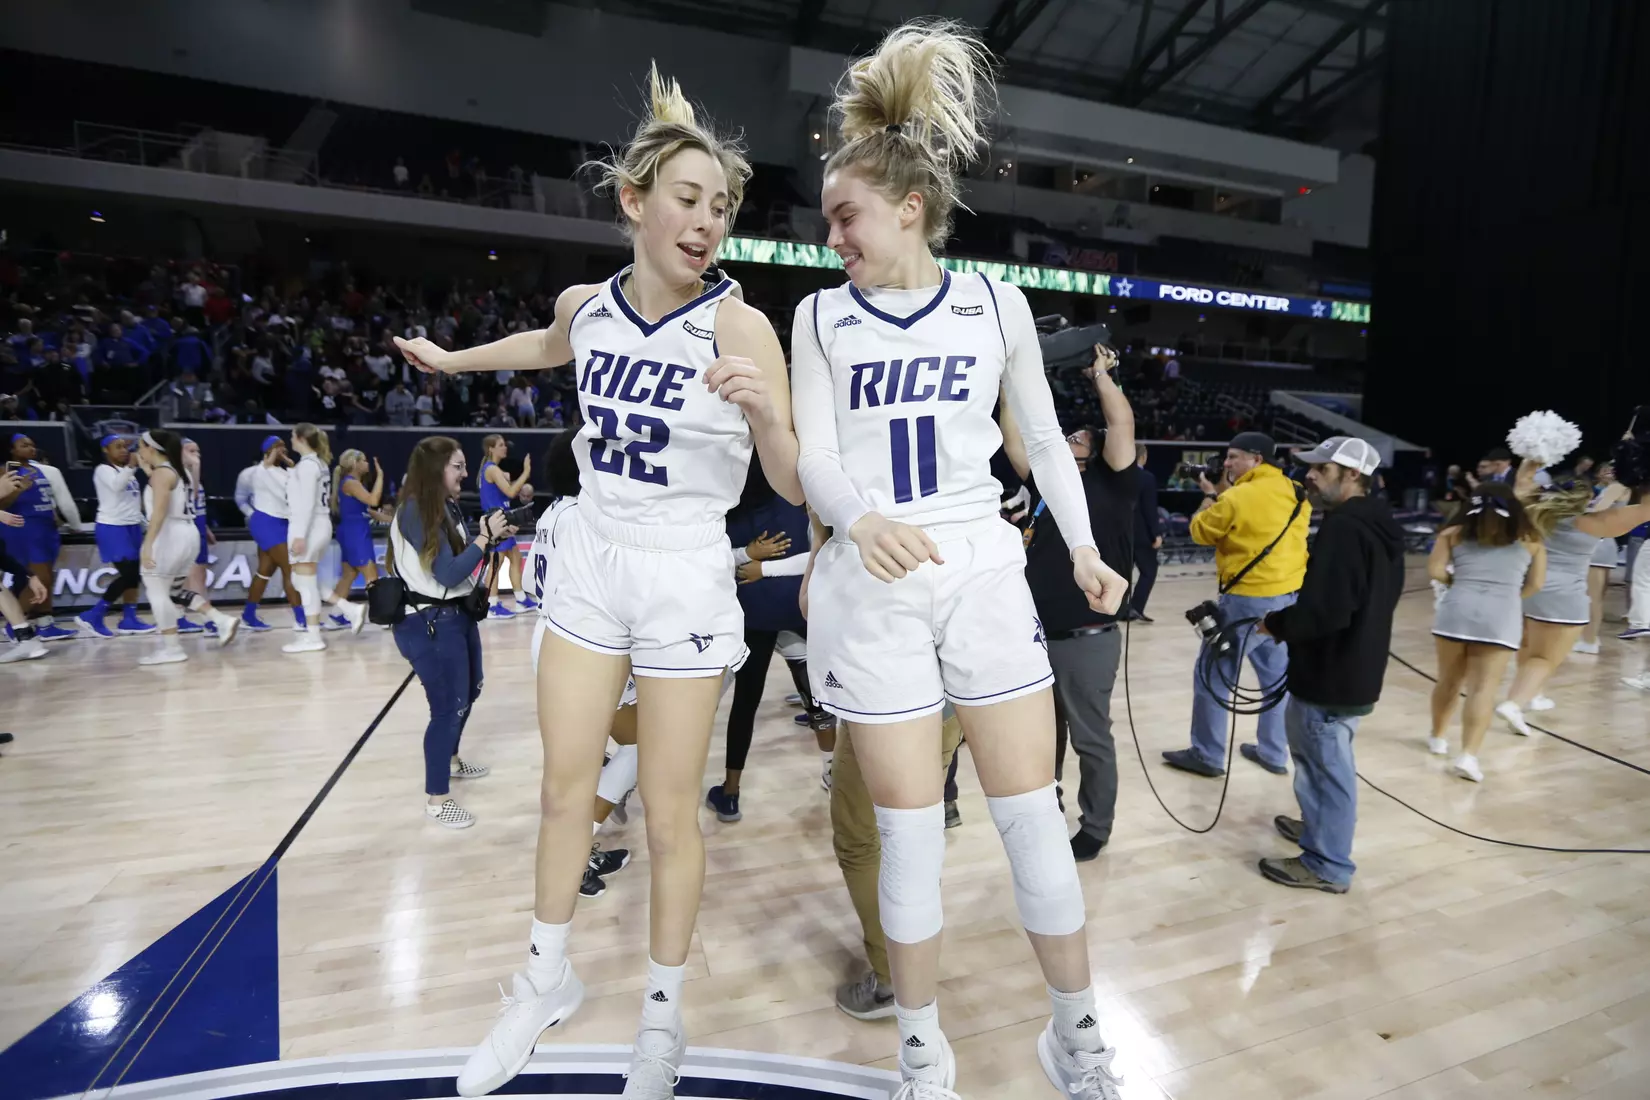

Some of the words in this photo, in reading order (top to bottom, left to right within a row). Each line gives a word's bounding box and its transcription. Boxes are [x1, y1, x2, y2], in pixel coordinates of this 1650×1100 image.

[834, 319, 862, 329] adidas
[1159, 284, 1213, 304] FORD
[1216, 291, 1290, 312] CENTER
[579, 349, 697, 411] RICE
[850, 355, 977, 411] RICE
[588, 404, 671, 487] 22
[889, 415, 939, 504] 11
